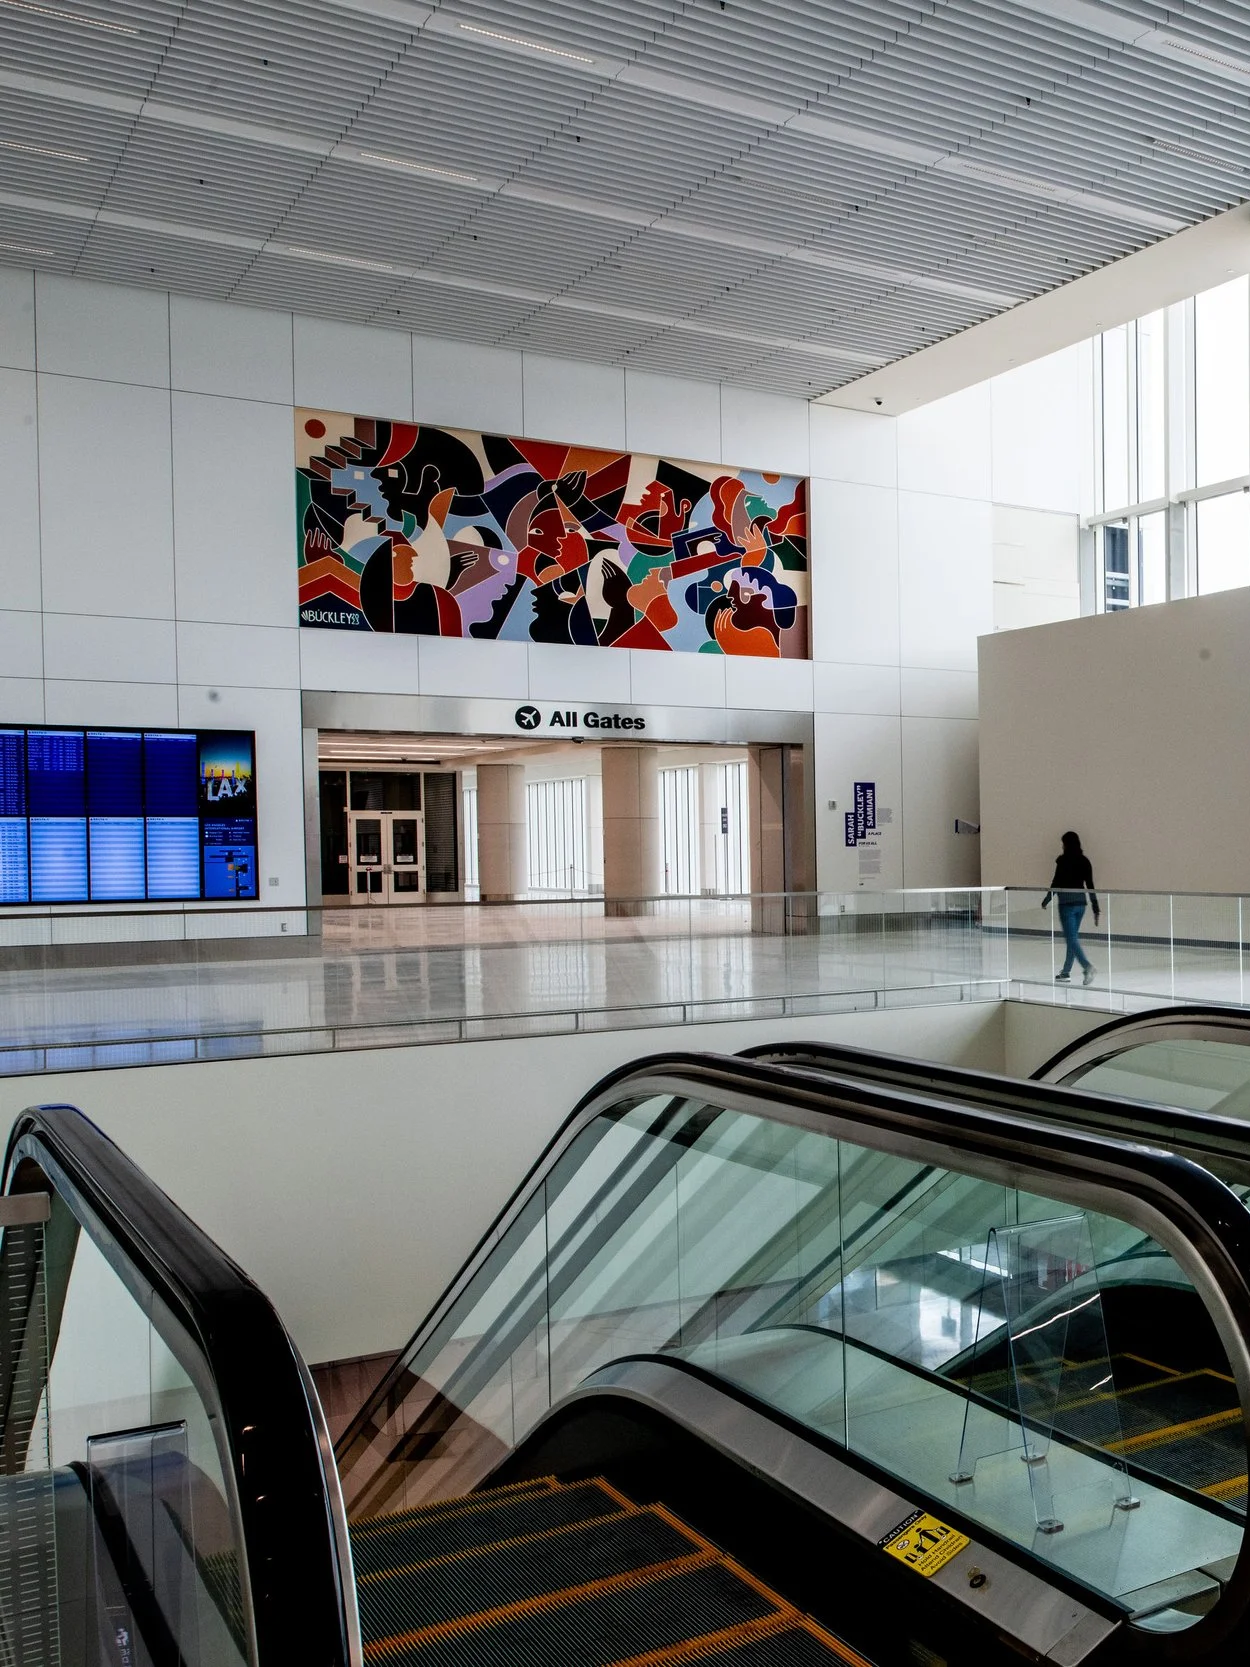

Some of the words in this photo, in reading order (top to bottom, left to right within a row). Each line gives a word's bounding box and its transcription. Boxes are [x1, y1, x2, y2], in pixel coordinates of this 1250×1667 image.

[549, 711, 577, 727] All
[583, 712, 646, 730] Gates
[207, 778, 247, 801] LAX
[883, 1513, 918, 1543] CAUTION
